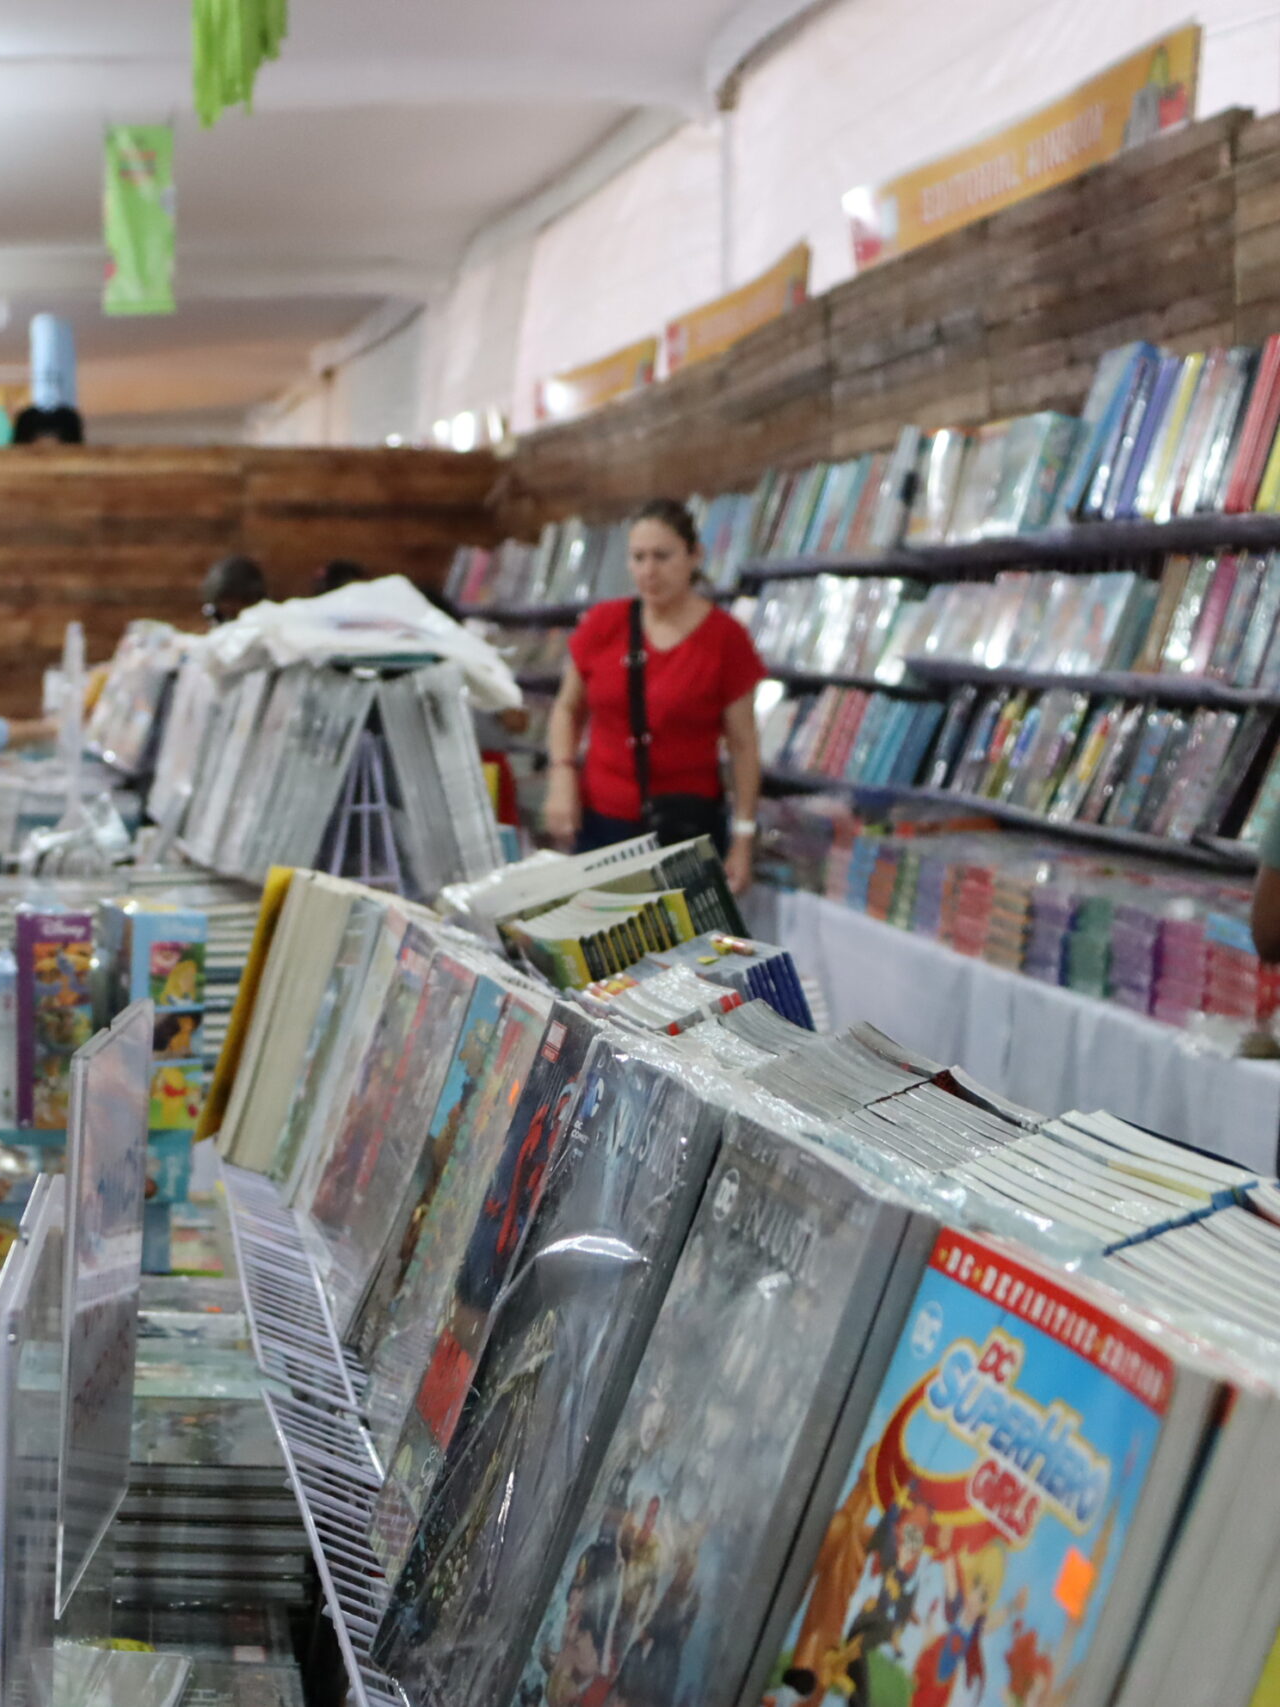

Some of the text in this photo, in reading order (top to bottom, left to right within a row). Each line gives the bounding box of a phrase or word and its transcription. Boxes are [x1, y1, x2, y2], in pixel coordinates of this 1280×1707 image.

[946, 1247, 975, 1280] DC
[980, 1264, 1101, 1356] DEFINITIVE
[976, 1341, 1018, 1384] DC
[970, 1458, 1041, 1539] GIRLS
